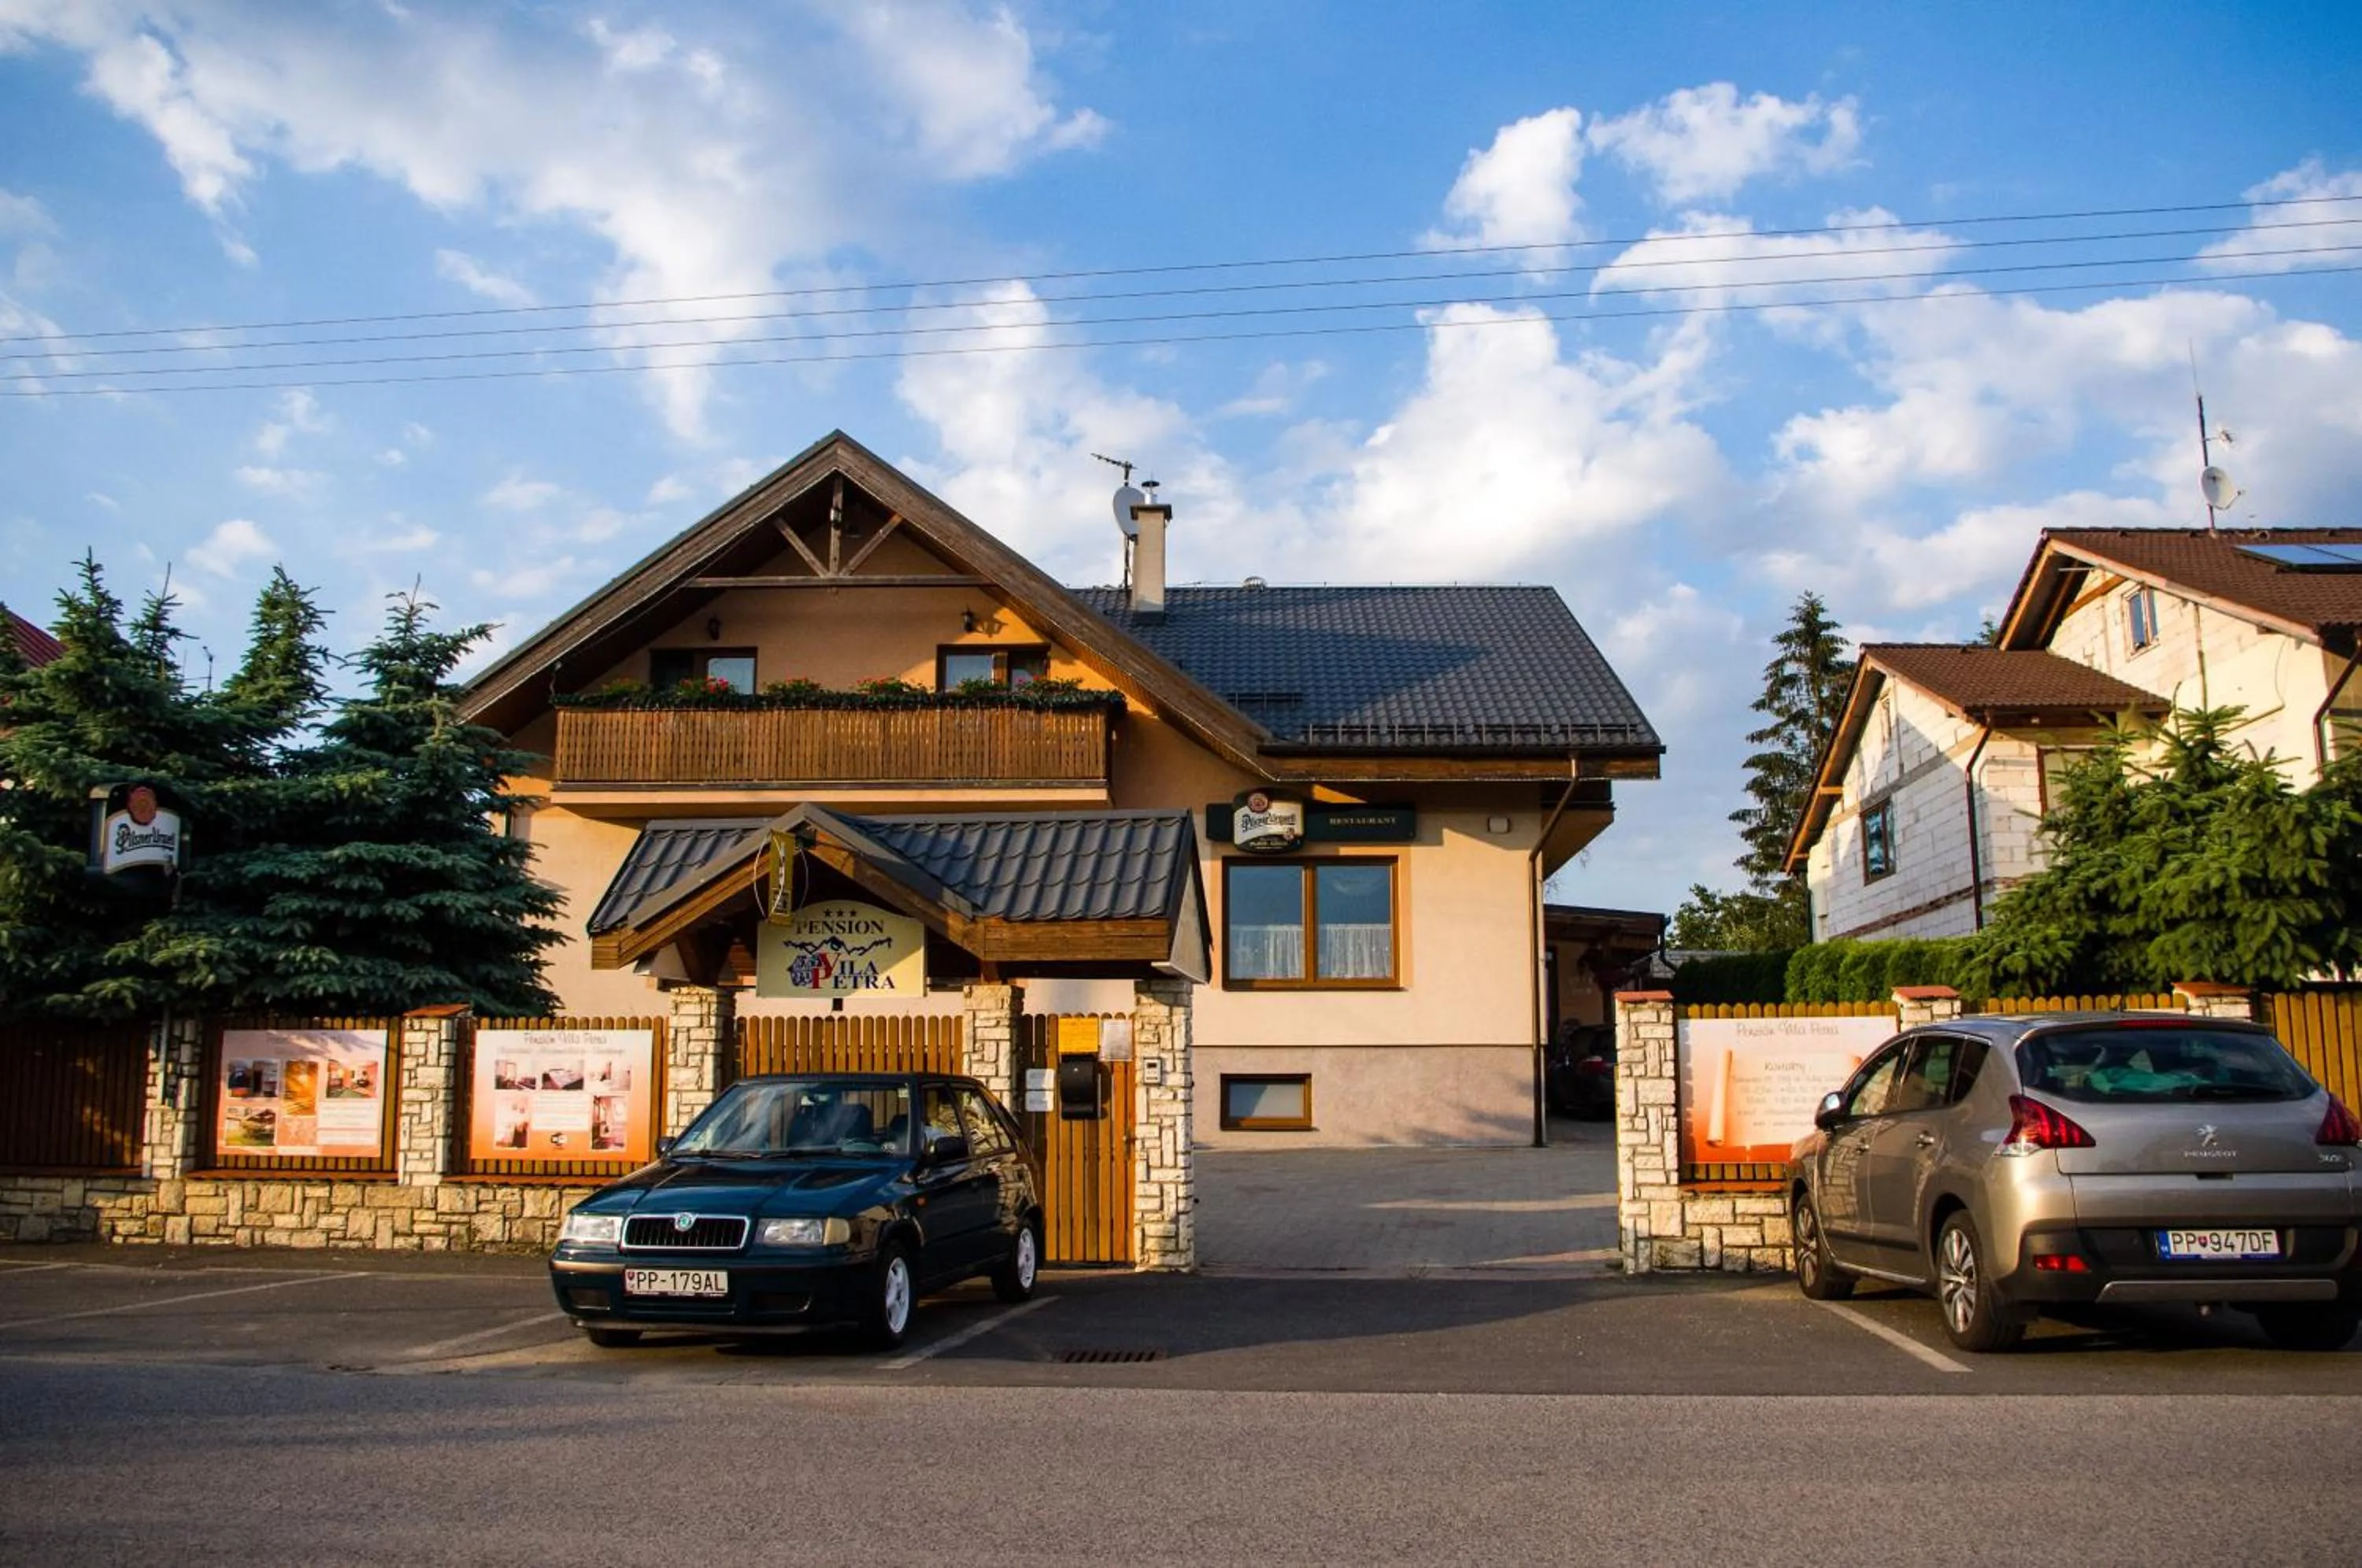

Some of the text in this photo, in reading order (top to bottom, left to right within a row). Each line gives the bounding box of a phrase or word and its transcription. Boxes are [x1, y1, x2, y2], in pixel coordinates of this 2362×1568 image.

[796, 919, 884, 935] PENSION
[809, 967, 896, 989] PETRA
[2209, 1232, 2273, 1252] 947DF
[636, 1271, 725, 1292] PP-179AL
